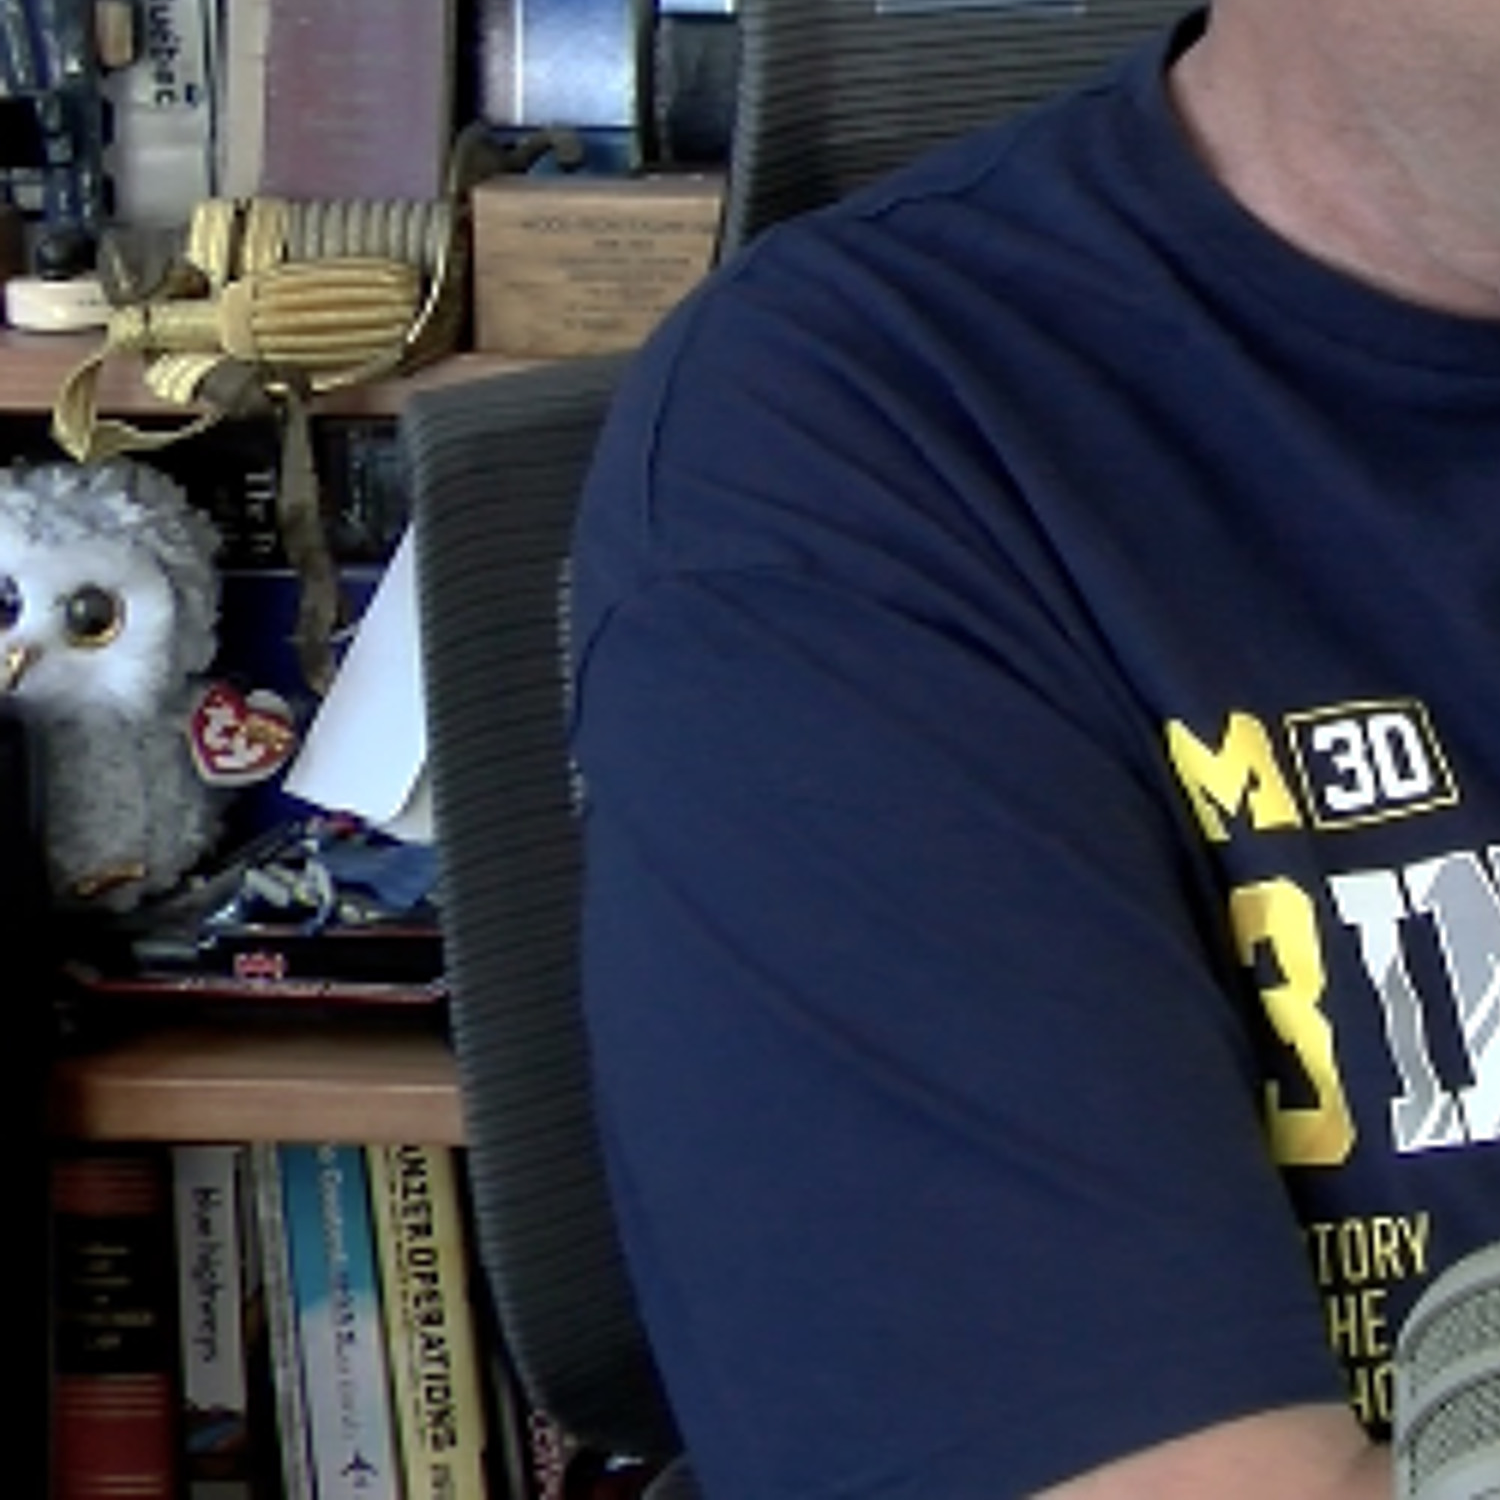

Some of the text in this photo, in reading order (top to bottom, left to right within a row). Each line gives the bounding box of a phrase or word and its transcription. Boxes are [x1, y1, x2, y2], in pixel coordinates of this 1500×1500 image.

[1166, 711, 1434, 843] M 30
[1230, 876, 1357, 1167] 3
[1310, 1210, 1431, 1285] TORY
[408, 1245, 458, 1452] OPERATIONS
[1327, 1288, 1390, 1358] HE
